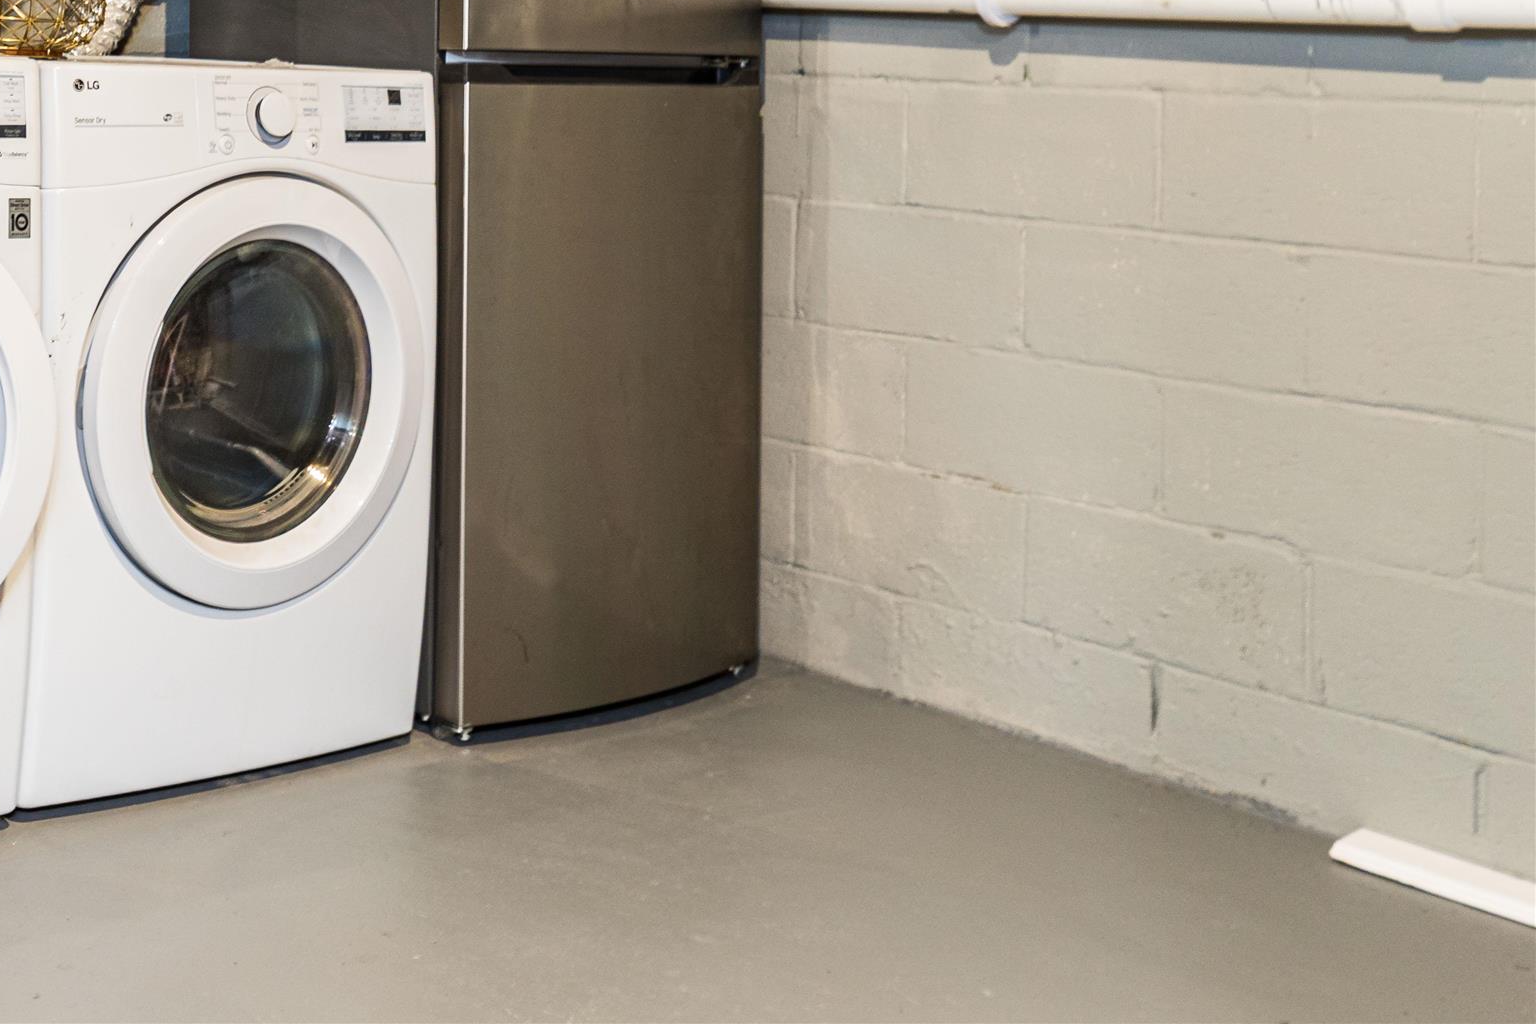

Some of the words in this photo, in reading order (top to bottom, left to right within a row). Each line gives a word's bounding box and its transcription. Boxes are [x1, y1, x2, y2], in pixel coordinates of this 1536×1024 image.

[87, 80, 100, 90] LG
[74, 116, 95, 124] Sensor
[95, 116, 106, 125] Dry
